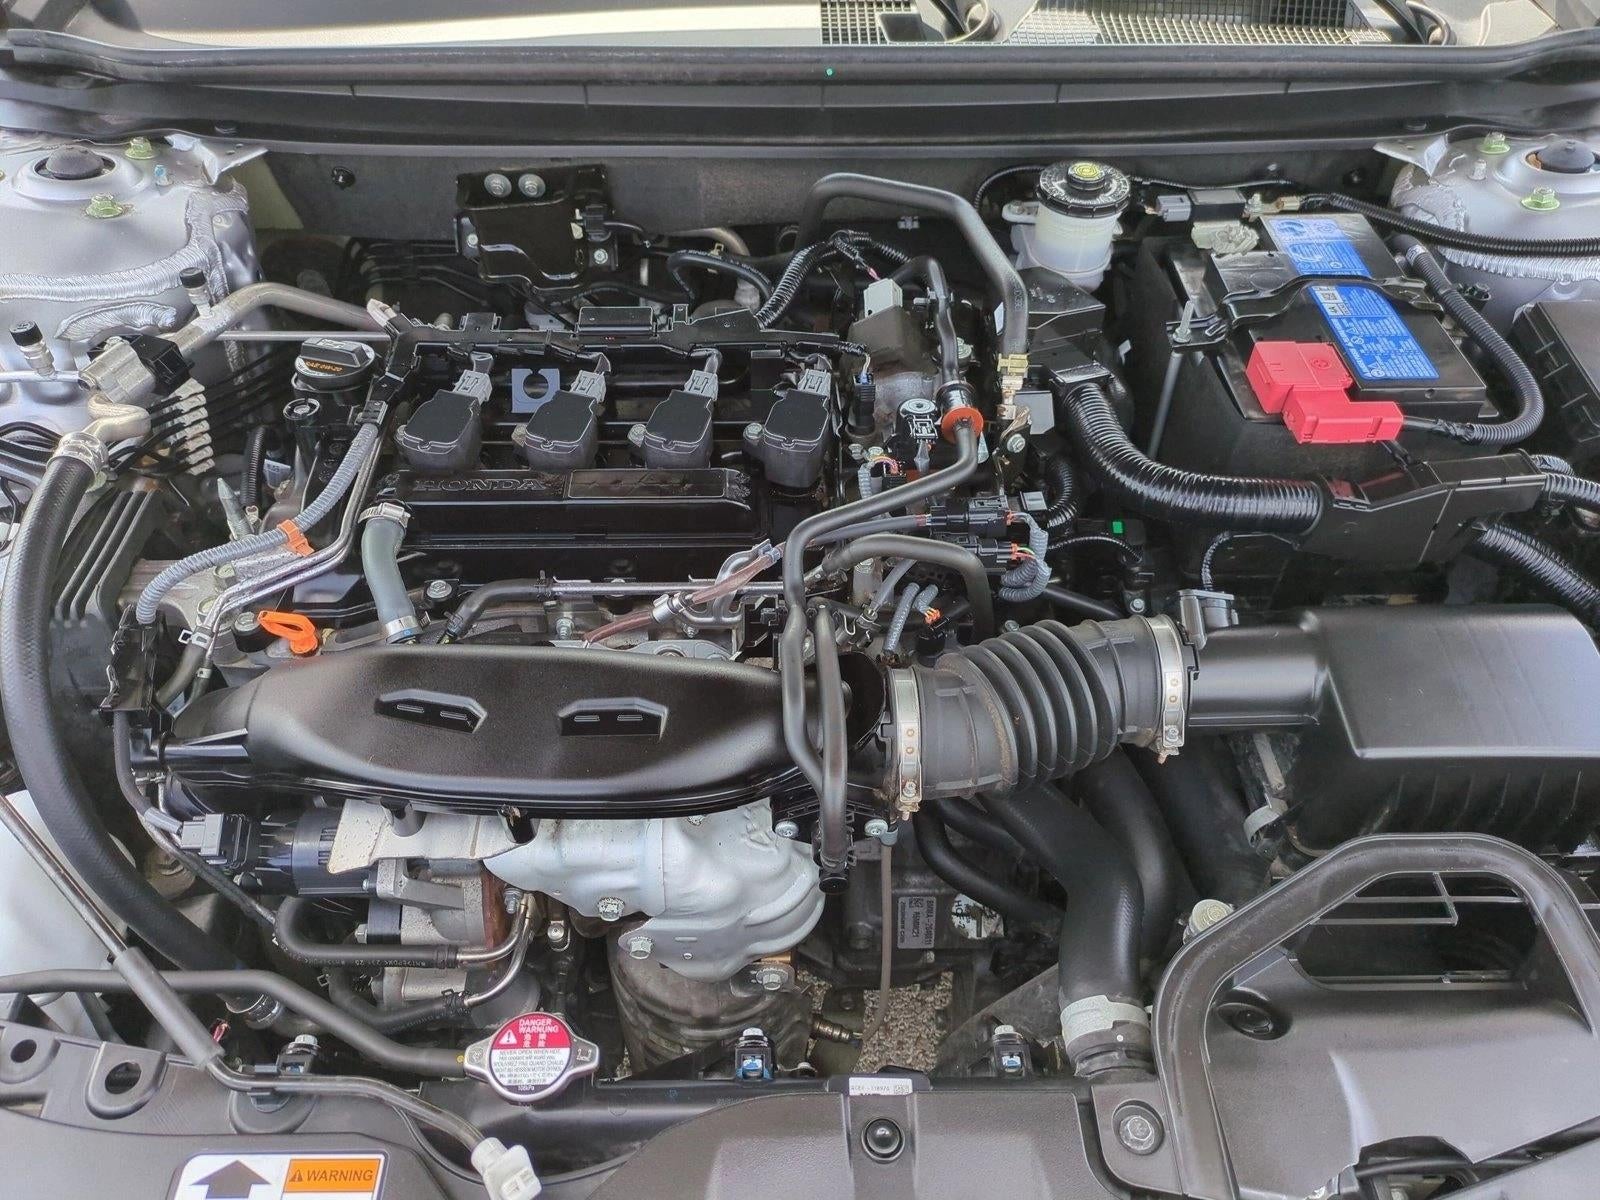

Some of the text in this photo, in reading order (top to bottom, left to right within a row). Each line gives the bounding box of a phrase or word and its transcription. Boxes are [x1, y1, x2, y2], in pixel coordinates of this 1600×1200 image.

[413, 478, 547, 492] HONDA
[519, 1018, 553, 1026] DANGER
[306, 1169, 373, 1182] WARNING
